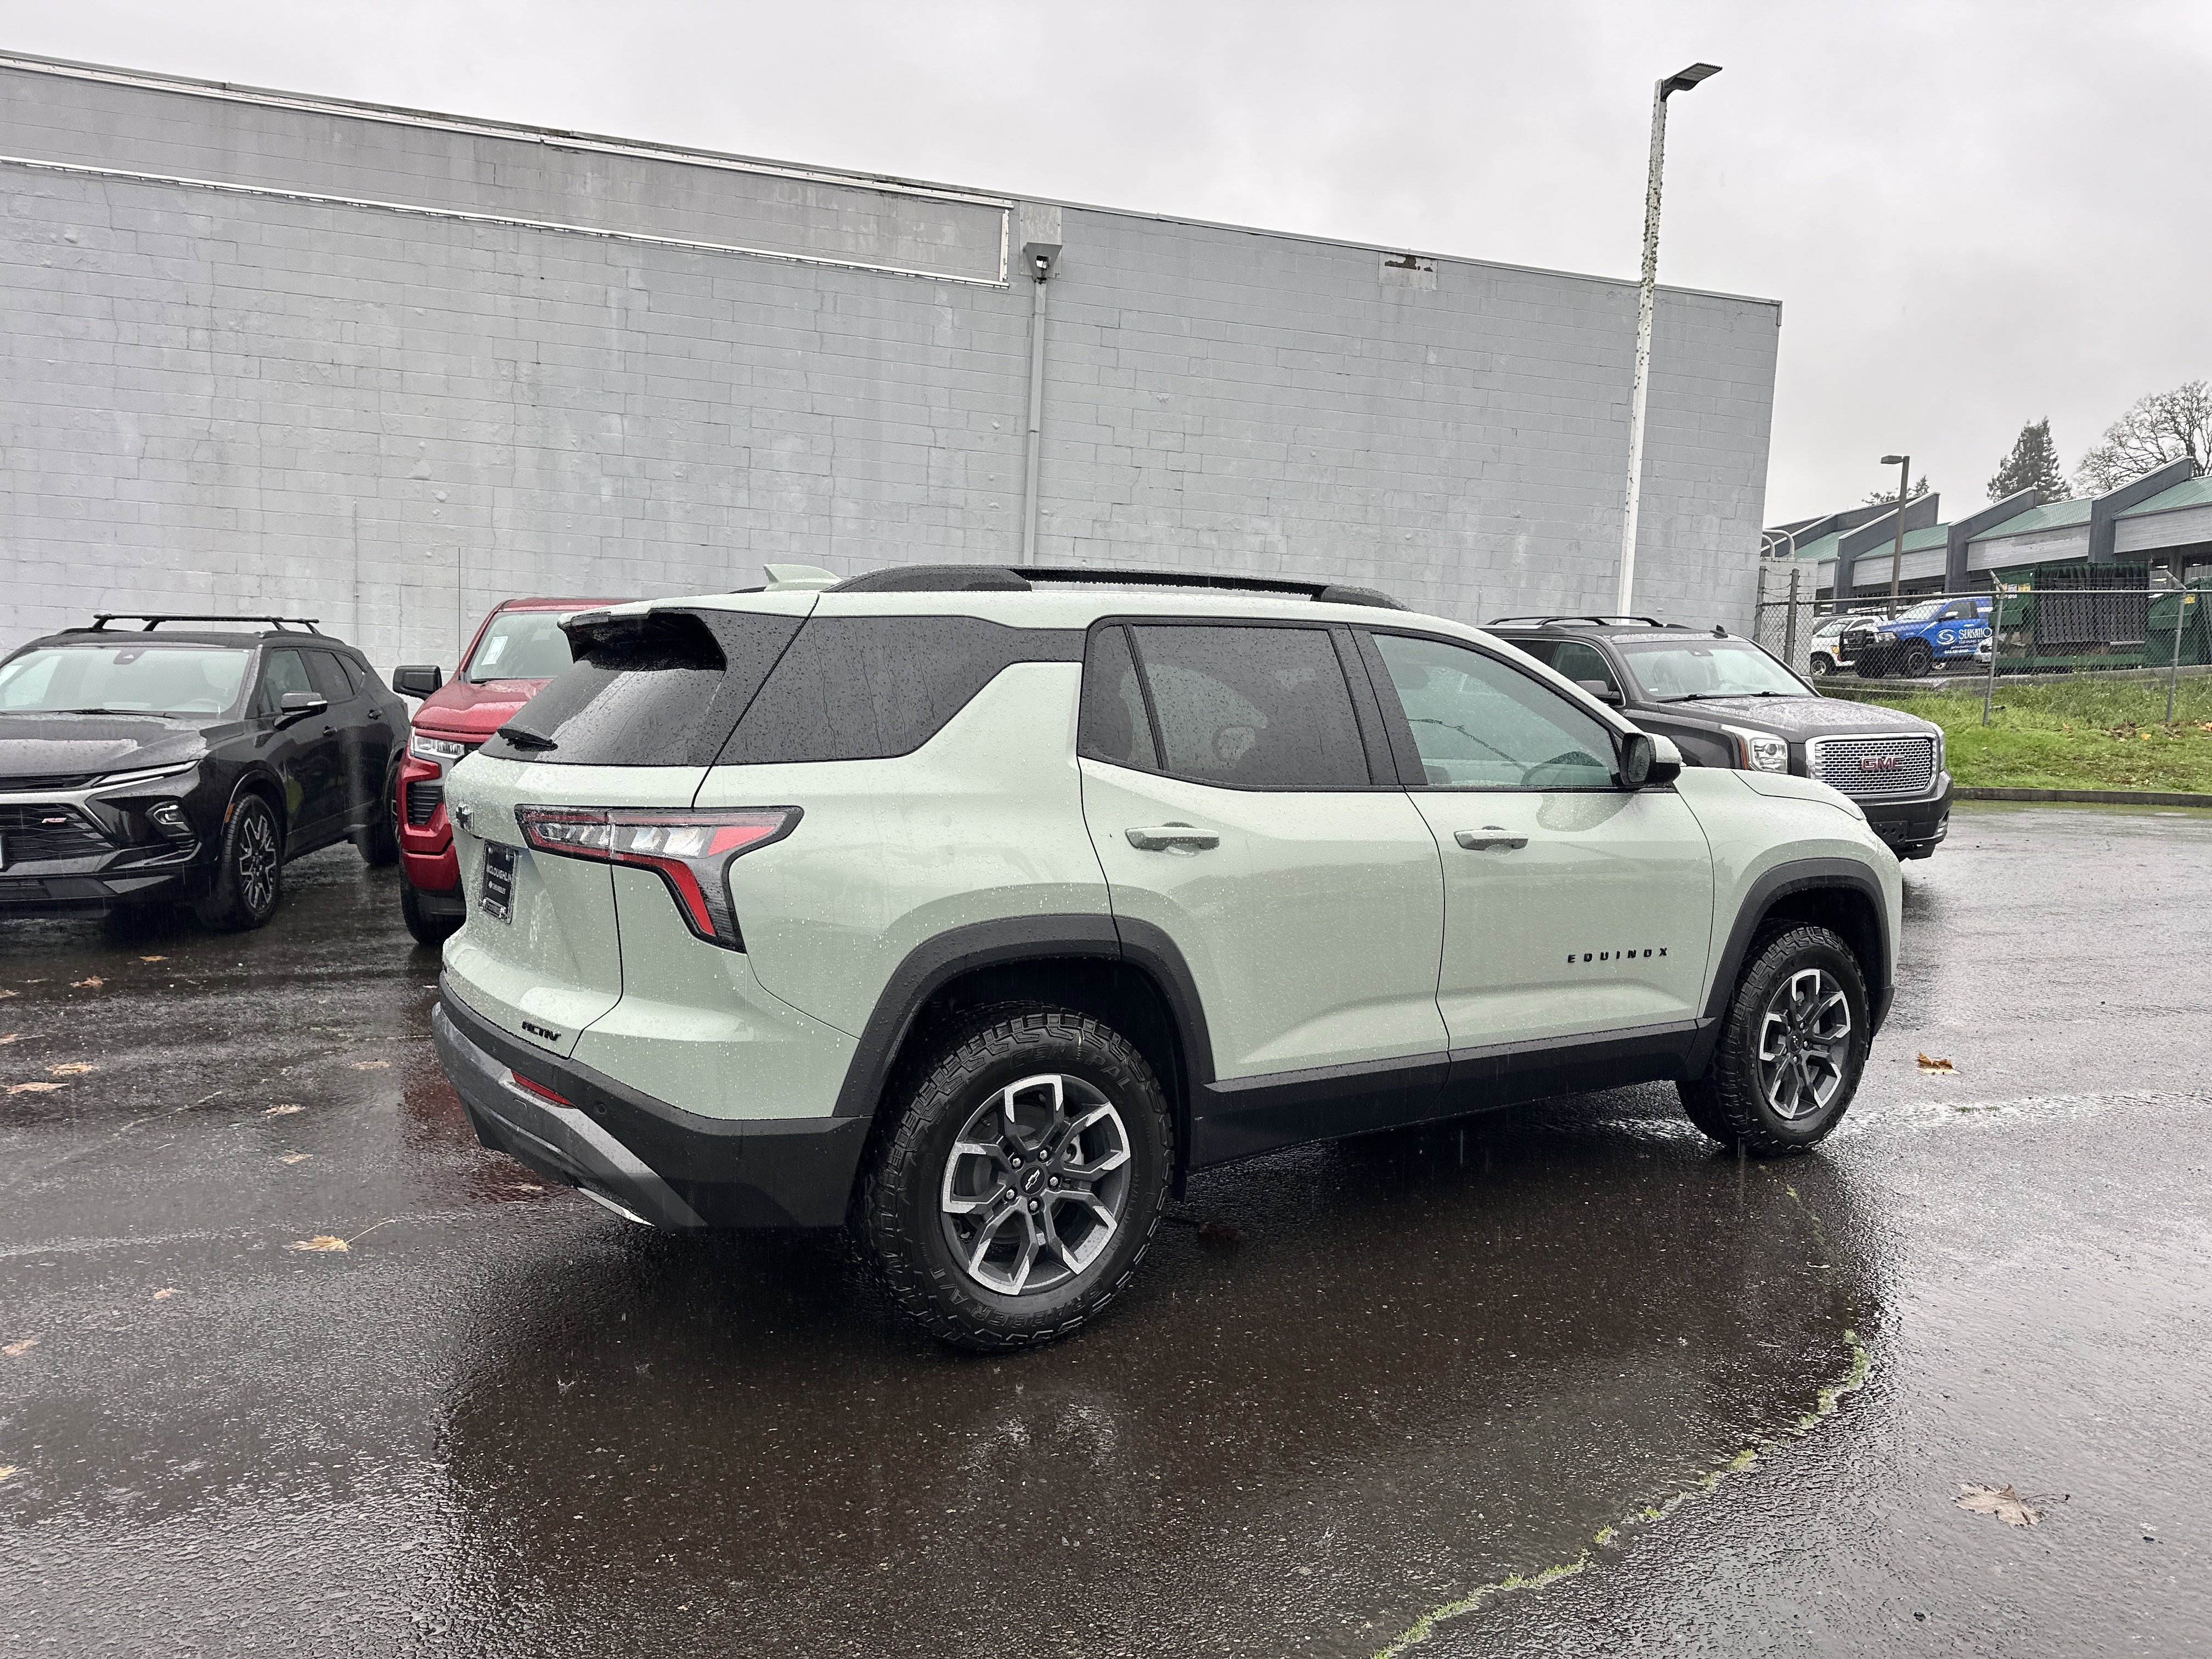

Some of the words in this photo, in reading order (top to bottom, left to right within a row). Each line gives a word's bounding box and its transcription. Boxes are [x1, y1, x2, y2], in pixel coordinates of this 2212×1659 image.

[1861, 755, 1905, 770] GMC
[1567, 947, 1668, 963] EQUINOX
[521, 1020, 562, 1041] ACTIV
[1010, 1043, 1131, 1091] GENERAL
